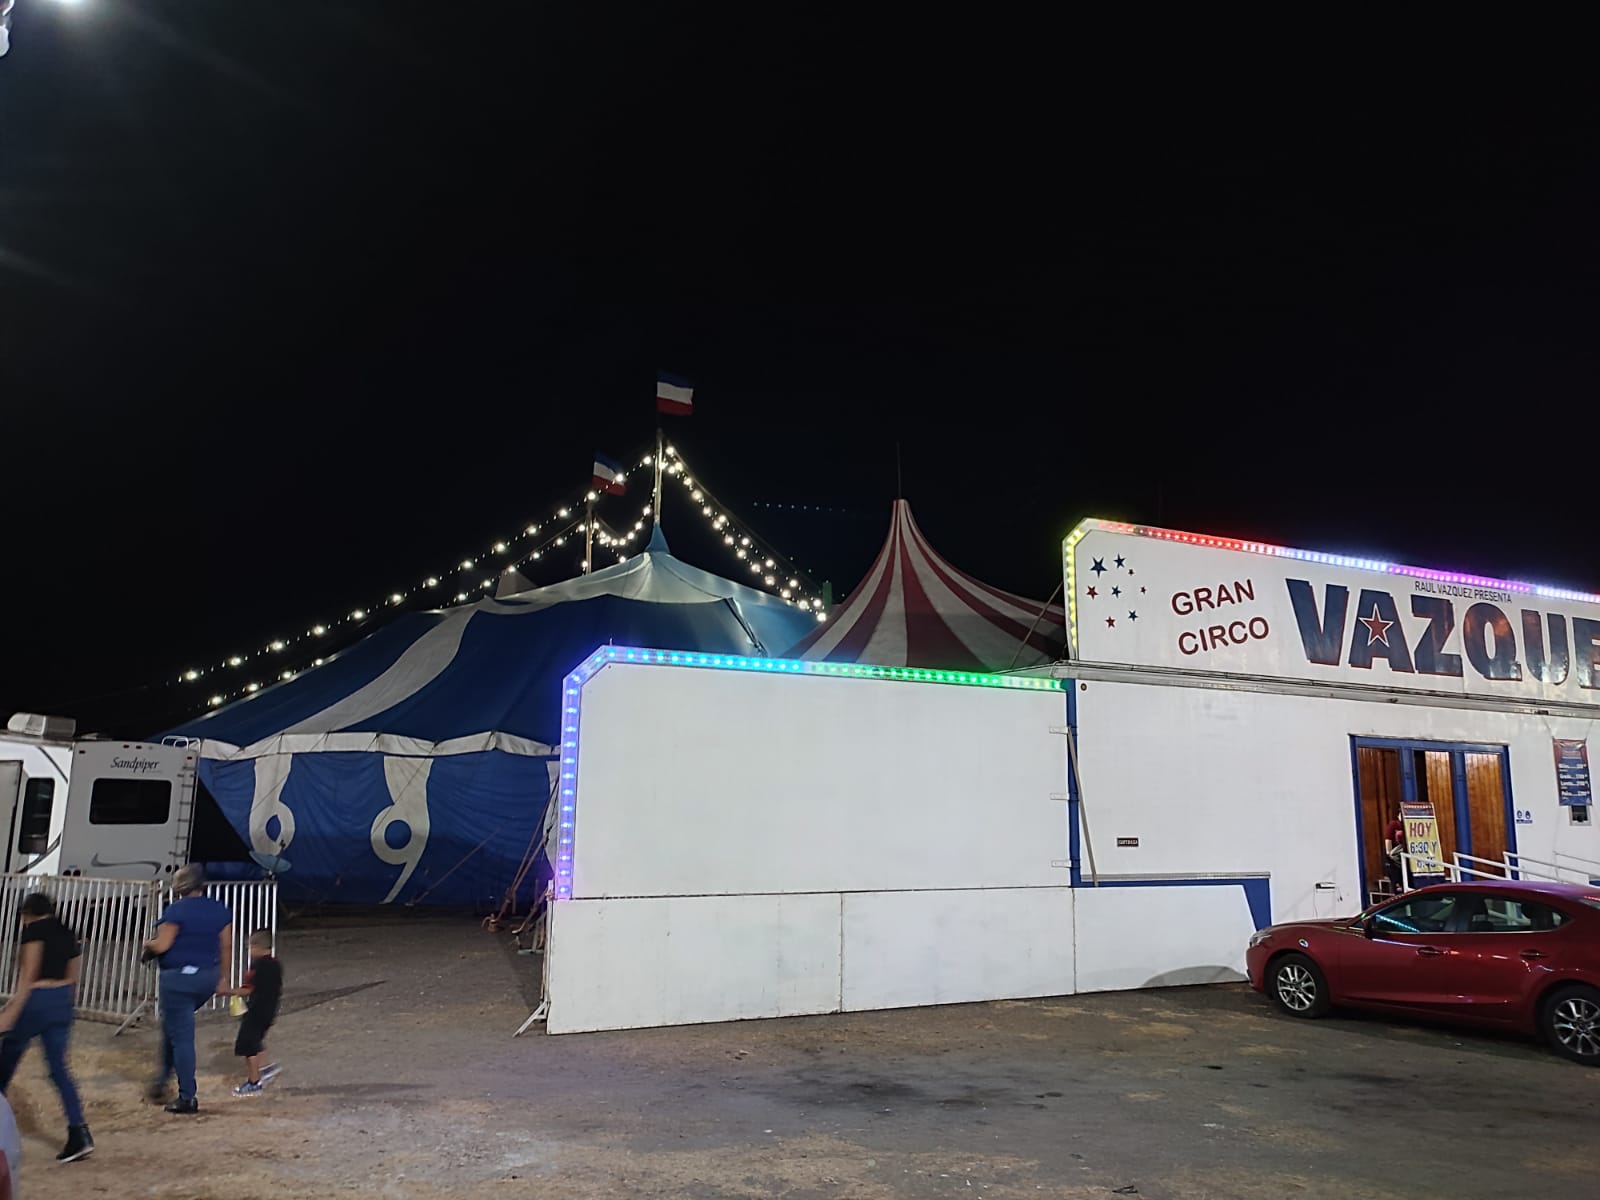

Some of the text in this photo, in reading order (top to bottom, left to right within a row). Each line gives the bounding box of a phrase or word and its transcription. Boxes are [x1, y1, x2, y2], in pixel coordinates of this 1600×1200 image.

[1171, 578, 1255, 616] GRAN
[1414, 580, 1513, 604] RAUL VAZQUEZ PRESENTA
[1178, 616, 1270, 656] CIRCO
[110, 756, 160, 773] Sandpiper
[1409, 822, 1432, 838] HOY
[1410, 841, 1438, 854] 6:30 Y
